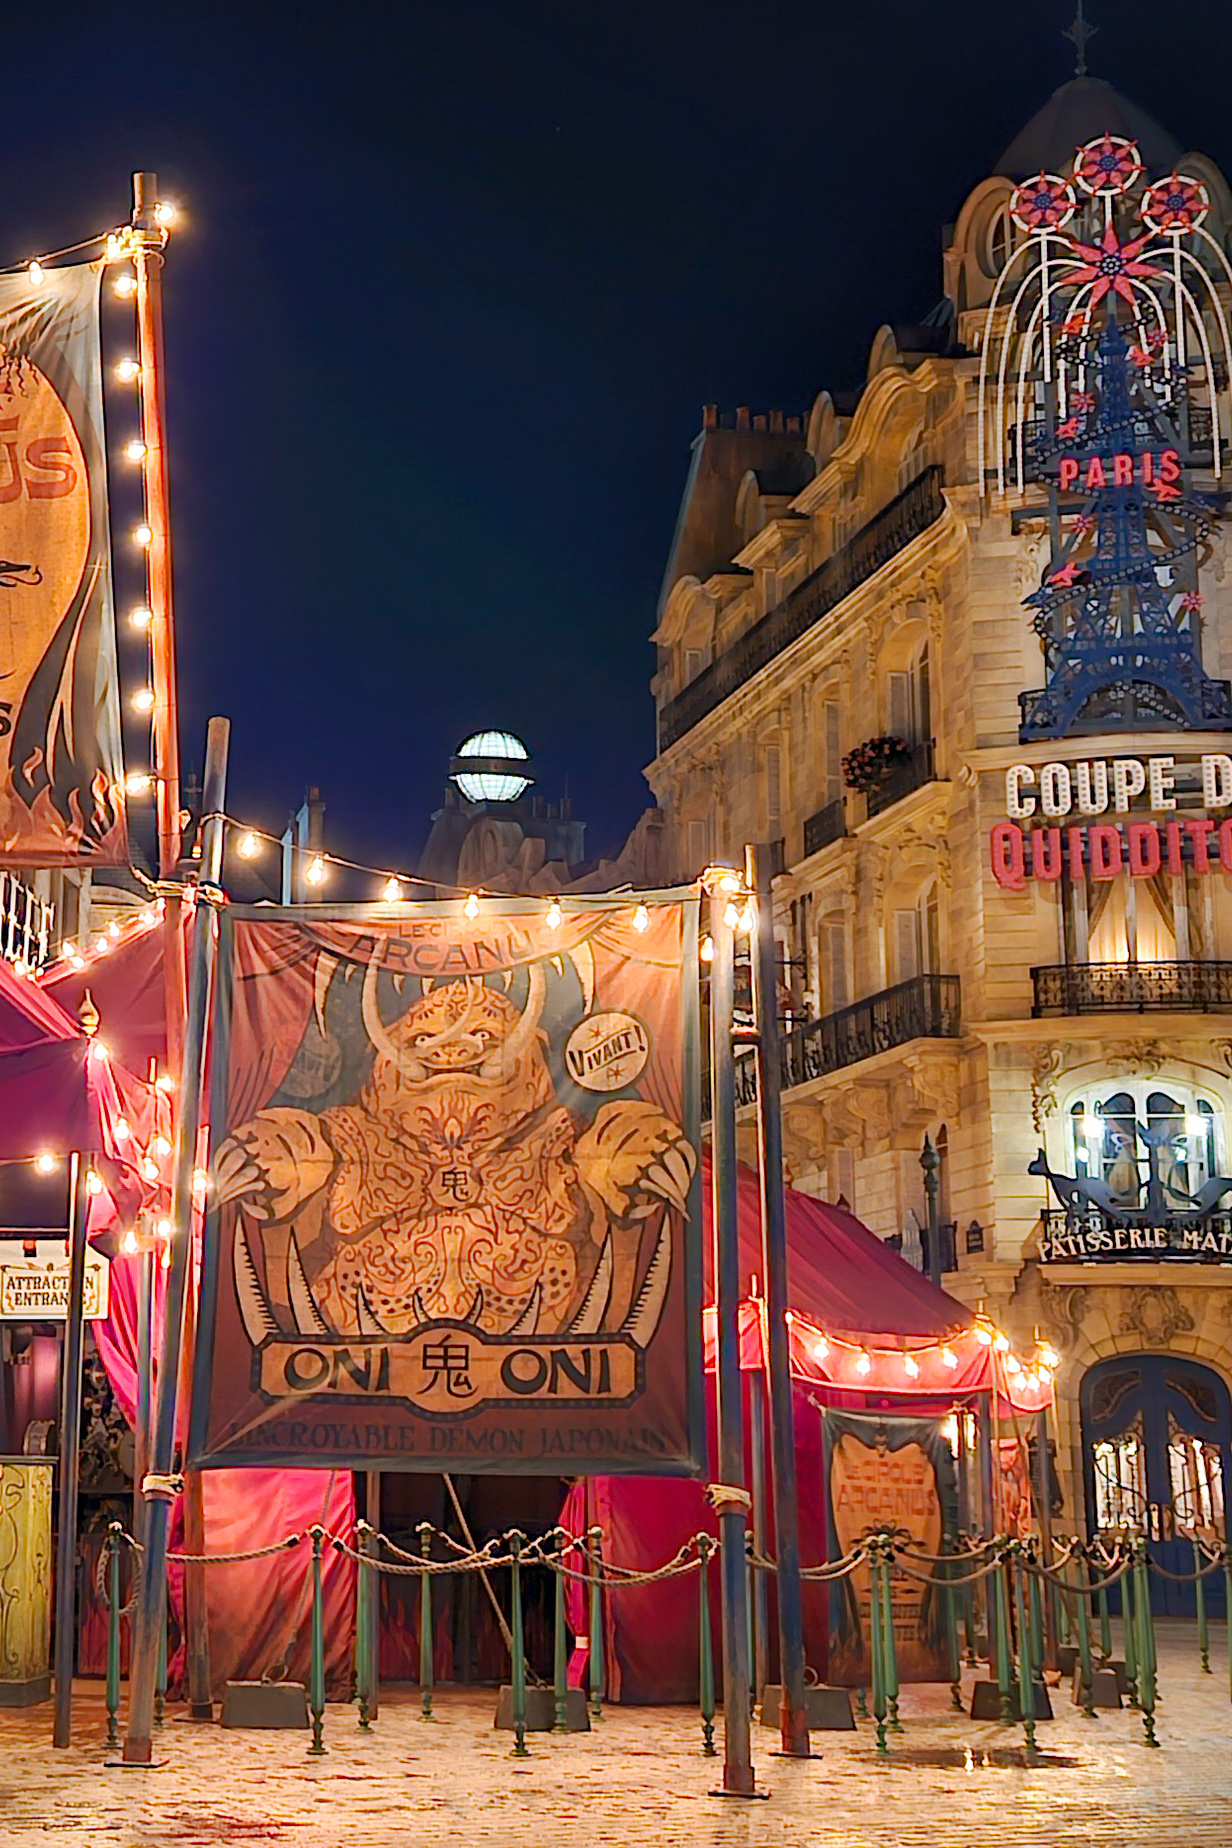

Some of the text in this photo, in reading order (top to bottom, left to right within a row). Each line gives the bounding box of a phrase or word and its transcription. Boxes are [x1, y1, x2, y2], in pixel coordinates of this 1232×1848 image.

[1058, 449, 1183, 491] PARIS
[1004, 757, 1178, 820] COUPE
[349, 928, 556, 972] ARCANU
[1036, 1227, 1232, 1262] PATISSERIE MAT
[6, 1275, 94, 1291] ATTRACTN
[283, 1333, 612, 1399] ONI 鬼 ONI
